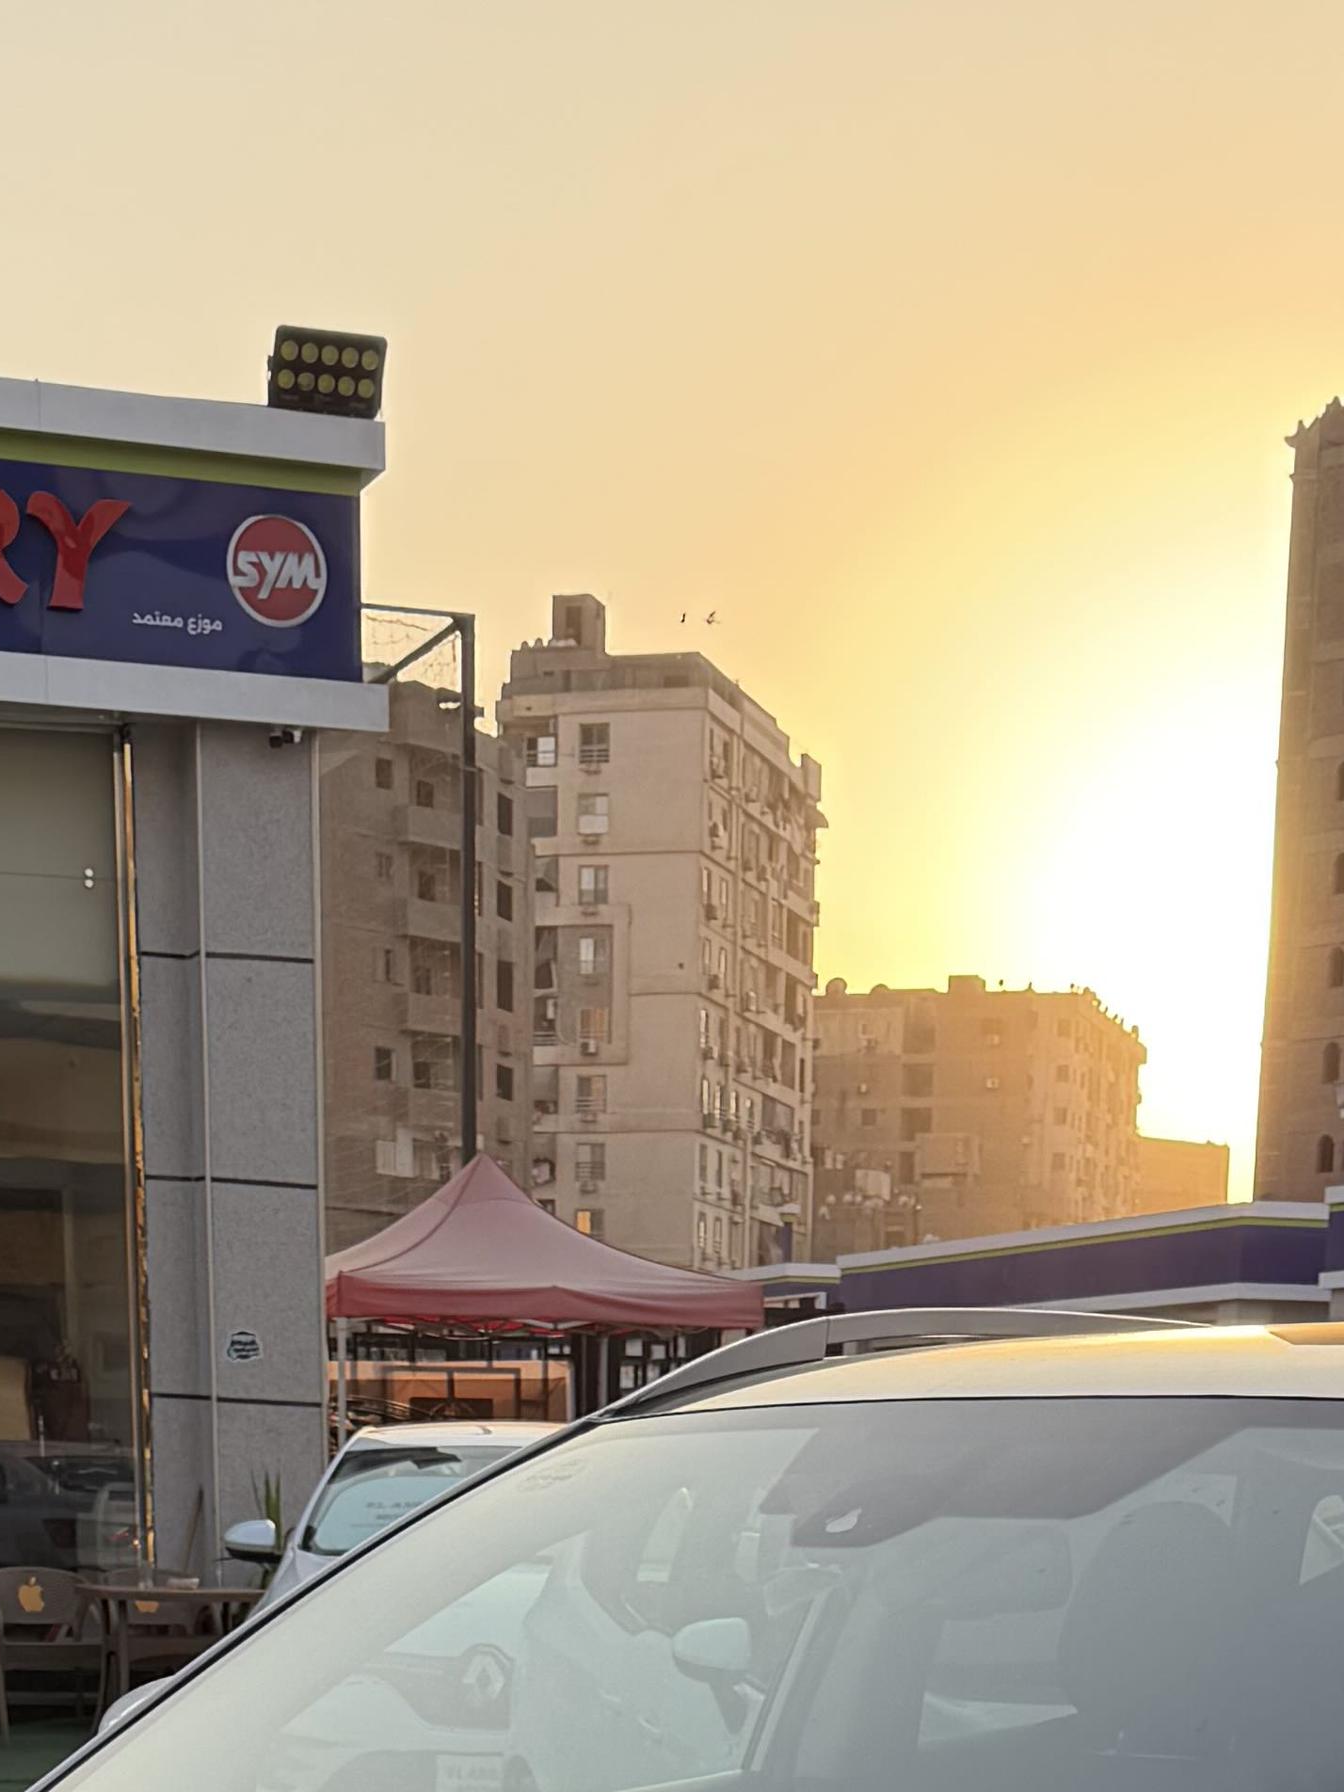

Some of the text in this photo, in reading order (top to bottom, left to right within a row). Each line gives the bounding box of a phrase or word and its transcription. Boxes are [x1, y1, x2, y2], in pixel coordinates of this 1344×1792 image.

[231, 550, 324, 599] SYM
[132, 611, 223, 635] موزع معتمد
